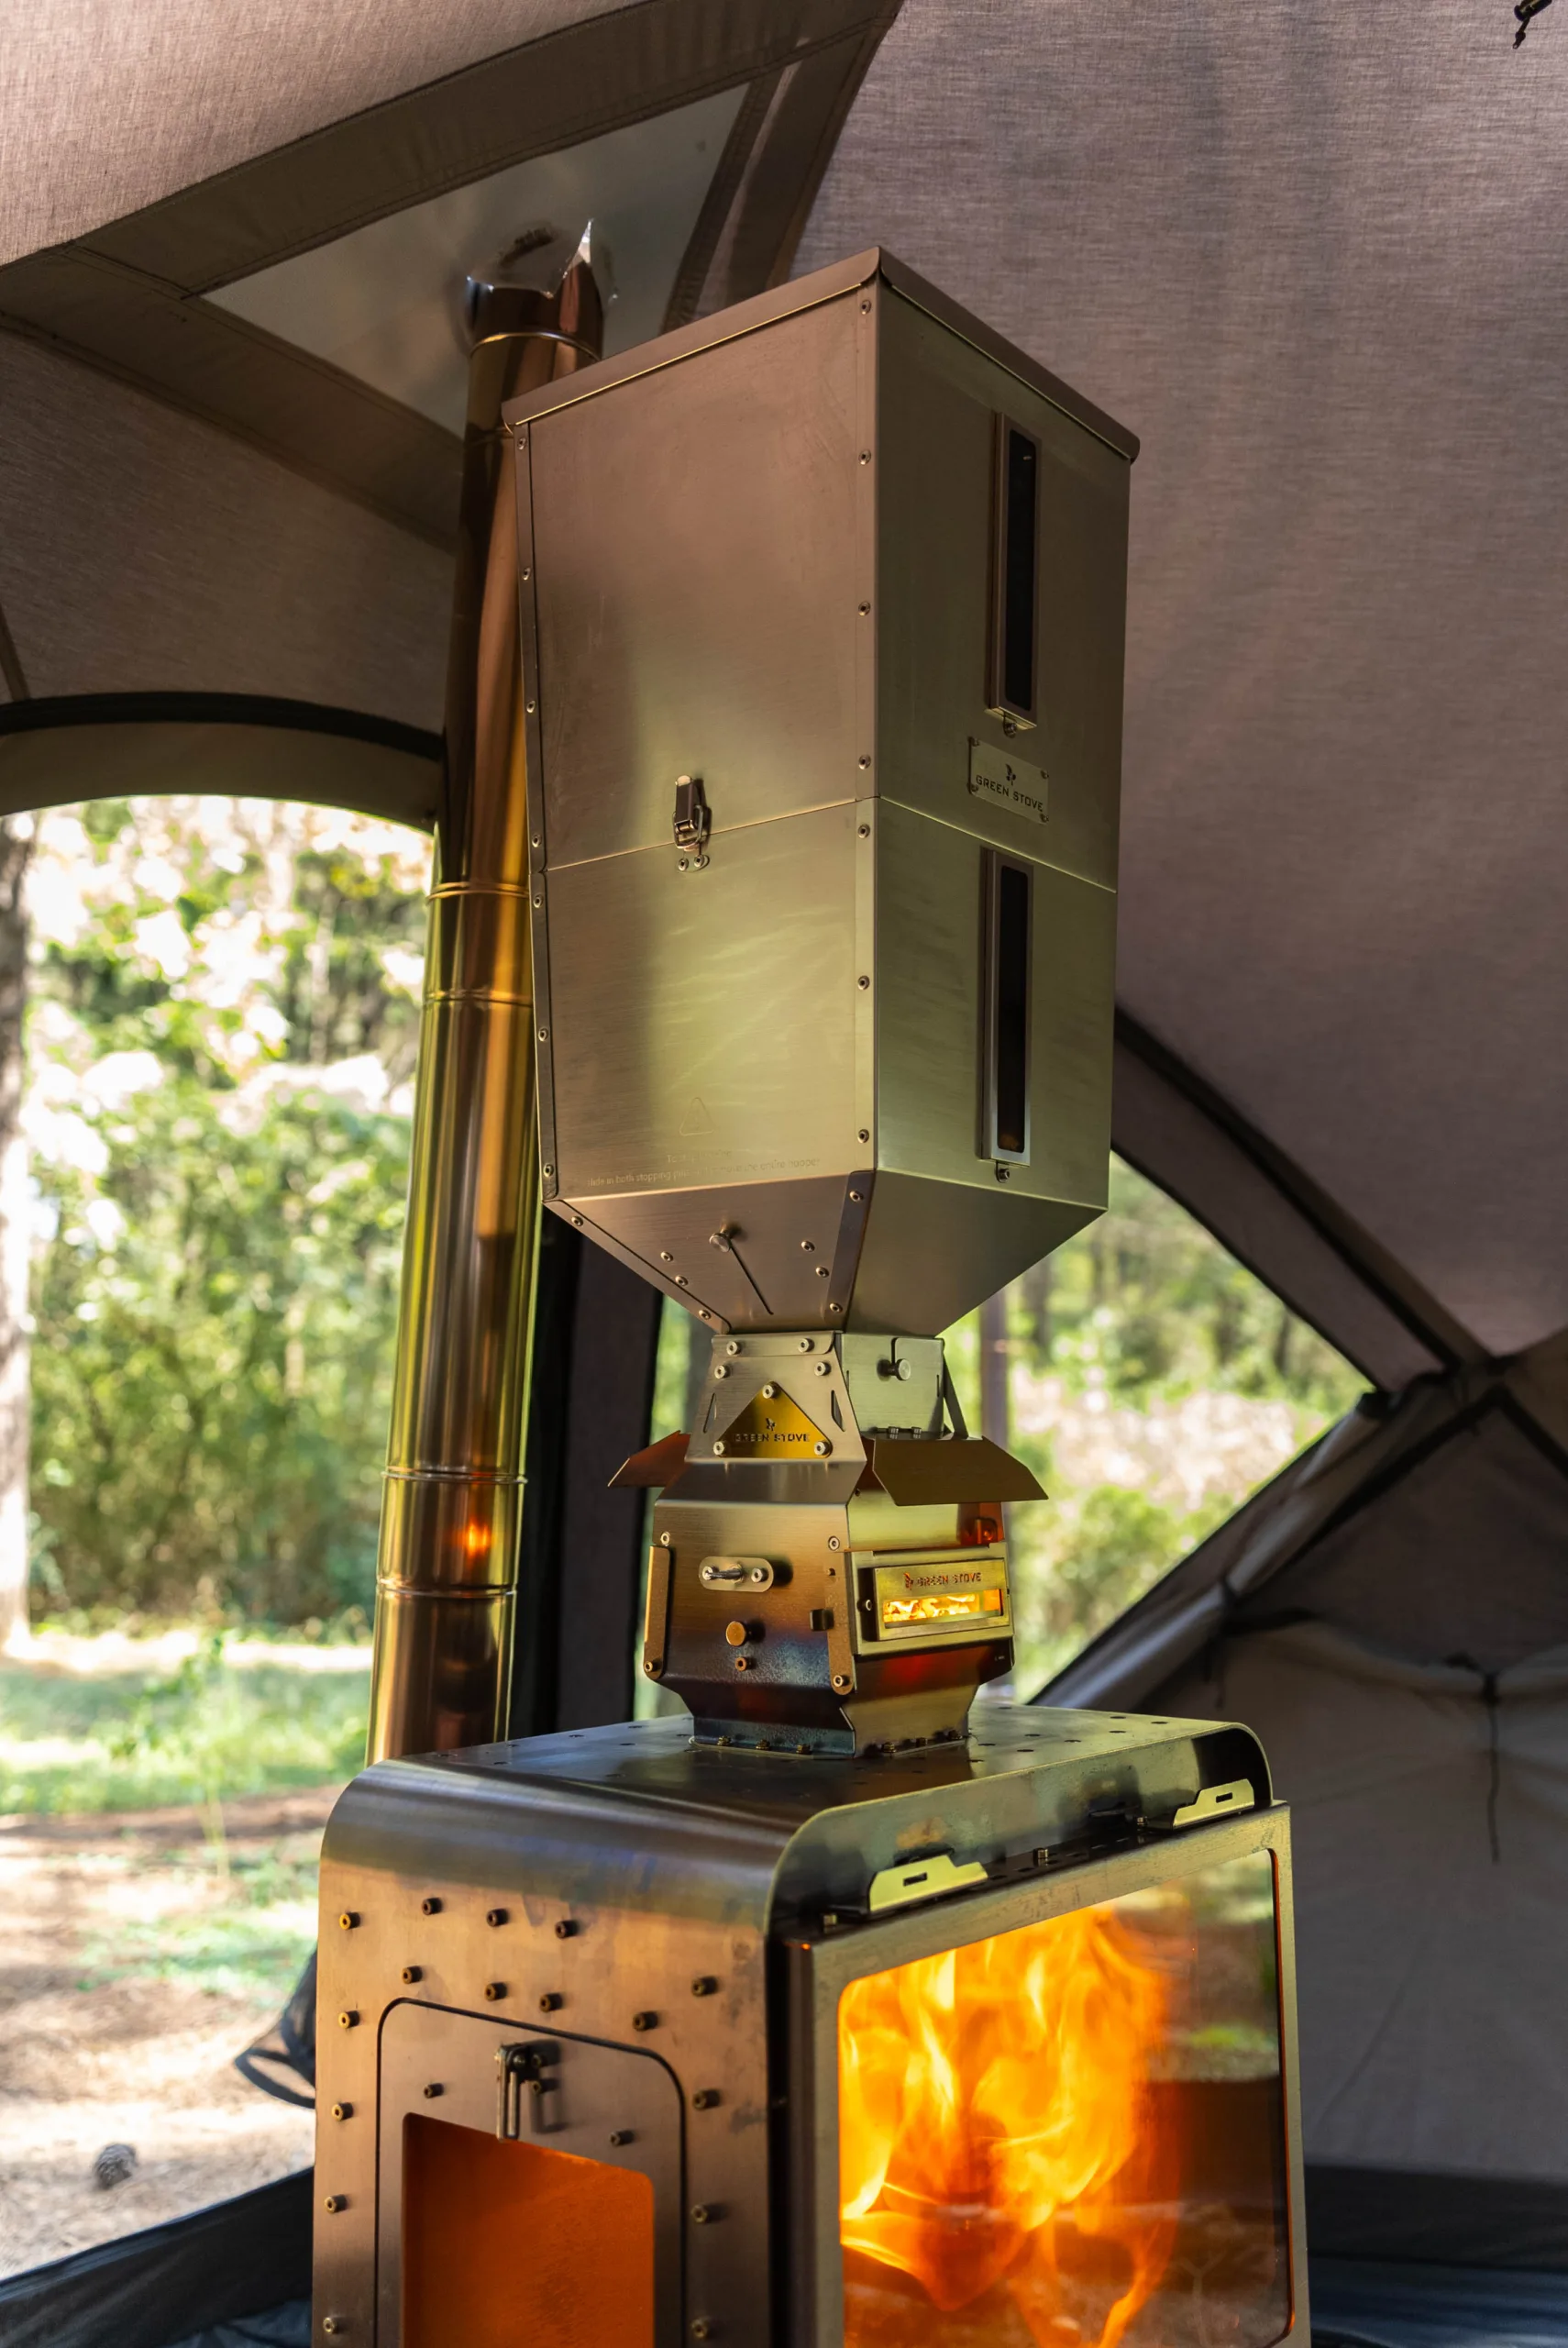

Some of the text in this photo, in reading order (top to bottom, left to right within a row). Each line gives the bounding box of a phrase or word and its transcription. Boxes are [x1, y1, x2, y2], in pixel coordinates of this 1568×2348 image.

[976, 774, 1043, 813] GREEN STOVE
[734, 1433, 810, 1443] GREEN STOVE
[917, 1572, 982, 1587] GREEN STOVE
